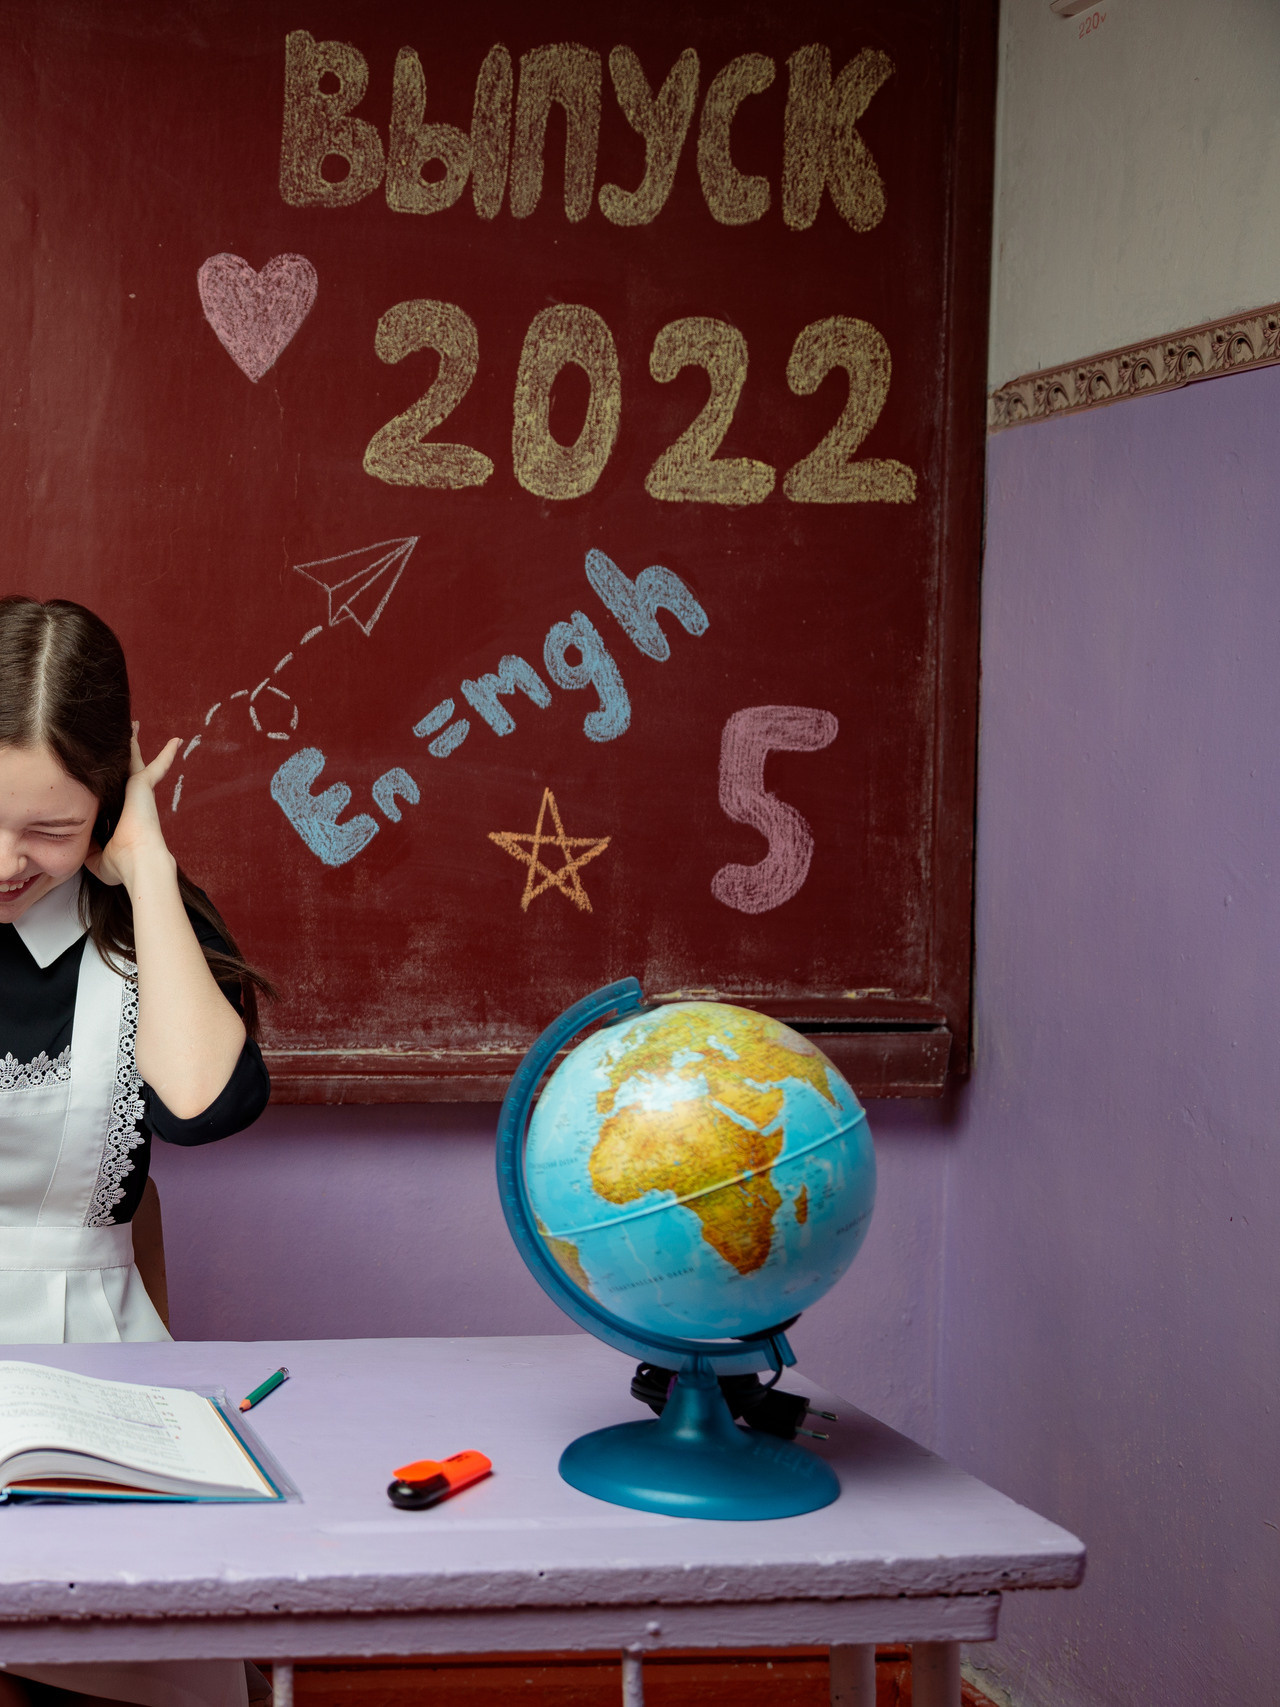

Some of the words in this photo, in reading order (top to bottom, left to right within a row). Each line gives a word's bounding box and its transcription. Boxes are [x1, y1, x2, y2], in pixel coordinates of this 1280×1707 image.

[278, 29, 896, 232] ВЫПУСК
[362, 299, 918, 505] 2022
[710, 704, 839, 915] 5
